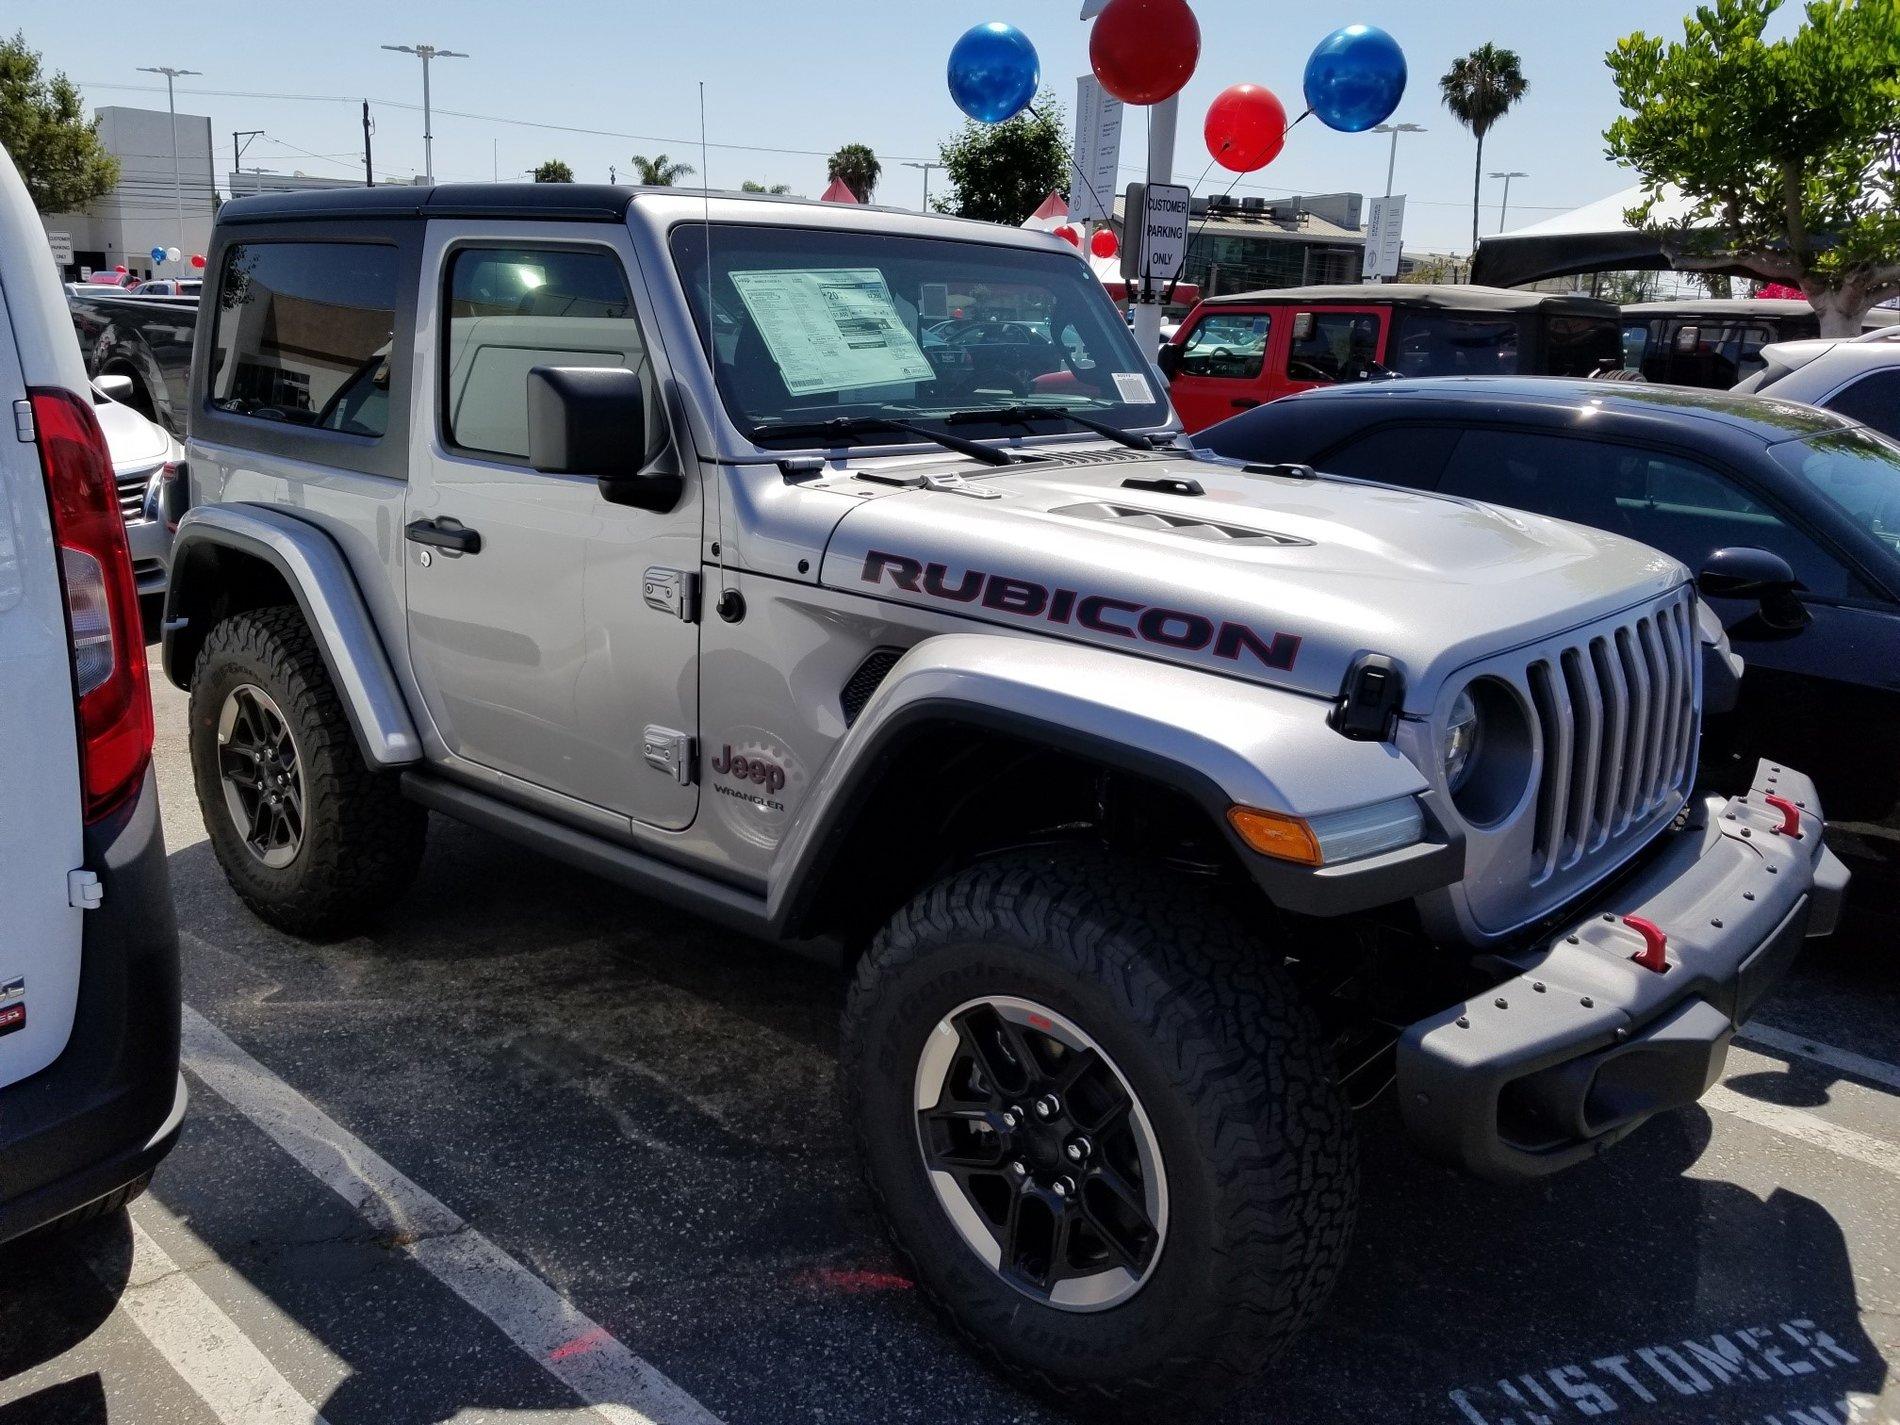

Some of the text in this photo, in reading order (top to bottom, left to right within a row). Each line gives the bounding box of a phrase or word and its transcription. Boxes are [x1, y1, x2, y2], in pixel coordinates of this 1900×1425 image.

[1148, 199, 1187, 213] CUSTOMER
[1147, 225, 1183, 239] PARKING
[1152, 252, 1173, 265] ONLY
[860, 549, 1303, 672] RUBICON
[711, 743, 786, 795] Jeep
[713, 782, 785, 812] WRANGLER
